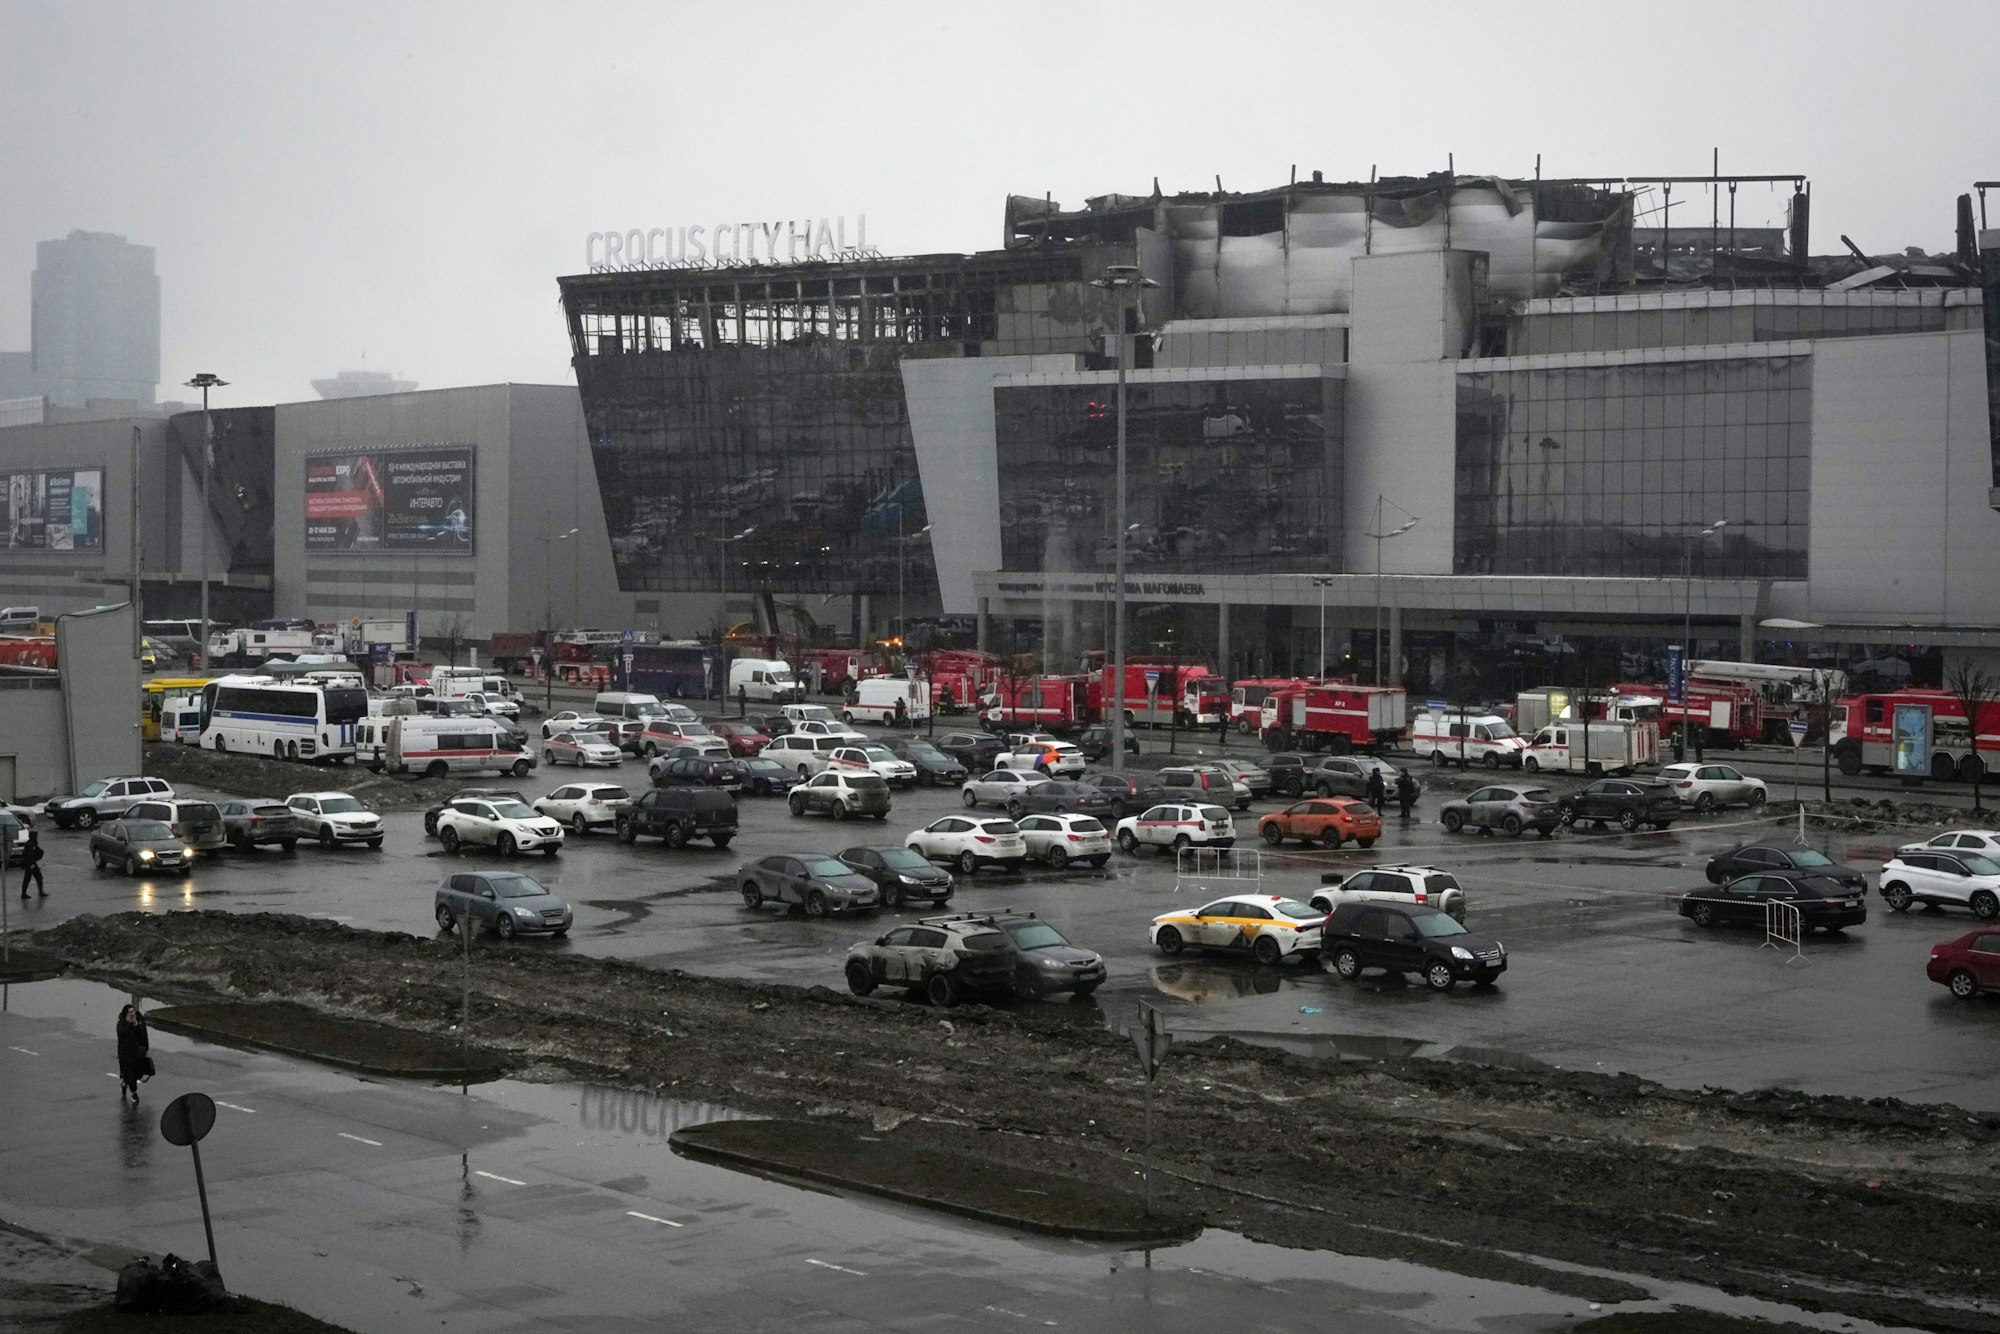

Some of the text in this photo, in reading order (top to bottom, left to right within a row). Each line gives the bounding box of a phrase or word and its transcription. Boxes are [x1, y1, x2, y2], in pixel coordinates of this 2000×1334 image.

[586, 214, 877, 267] CROCUS CITY HALL
[409, 497, 443, 508] ИНТЕРАВТО
[1143, 583, 1205, 595] МАГОМАЕВА
